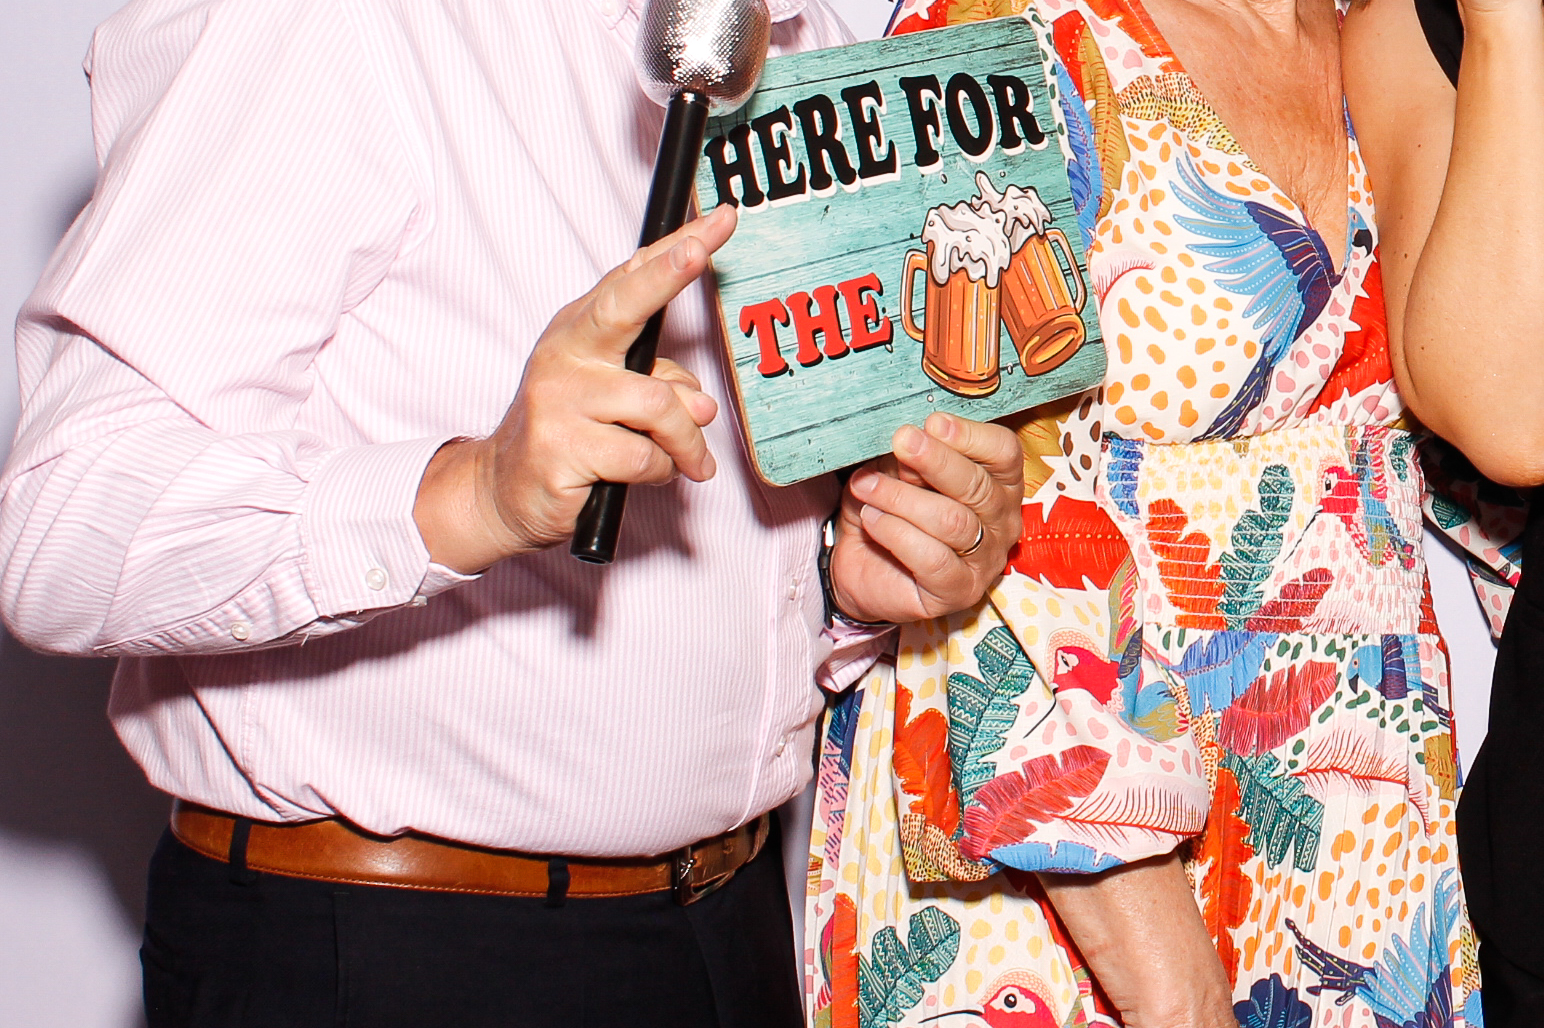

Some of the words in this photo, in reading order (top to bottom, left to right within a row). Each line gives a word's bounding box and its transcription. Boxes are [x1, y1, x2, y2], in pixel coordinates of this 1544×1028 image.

[703, 80, 899, 212] HERE
[899, 71, 1049, 171] FOR
[739, 272, 894, 378] THE
